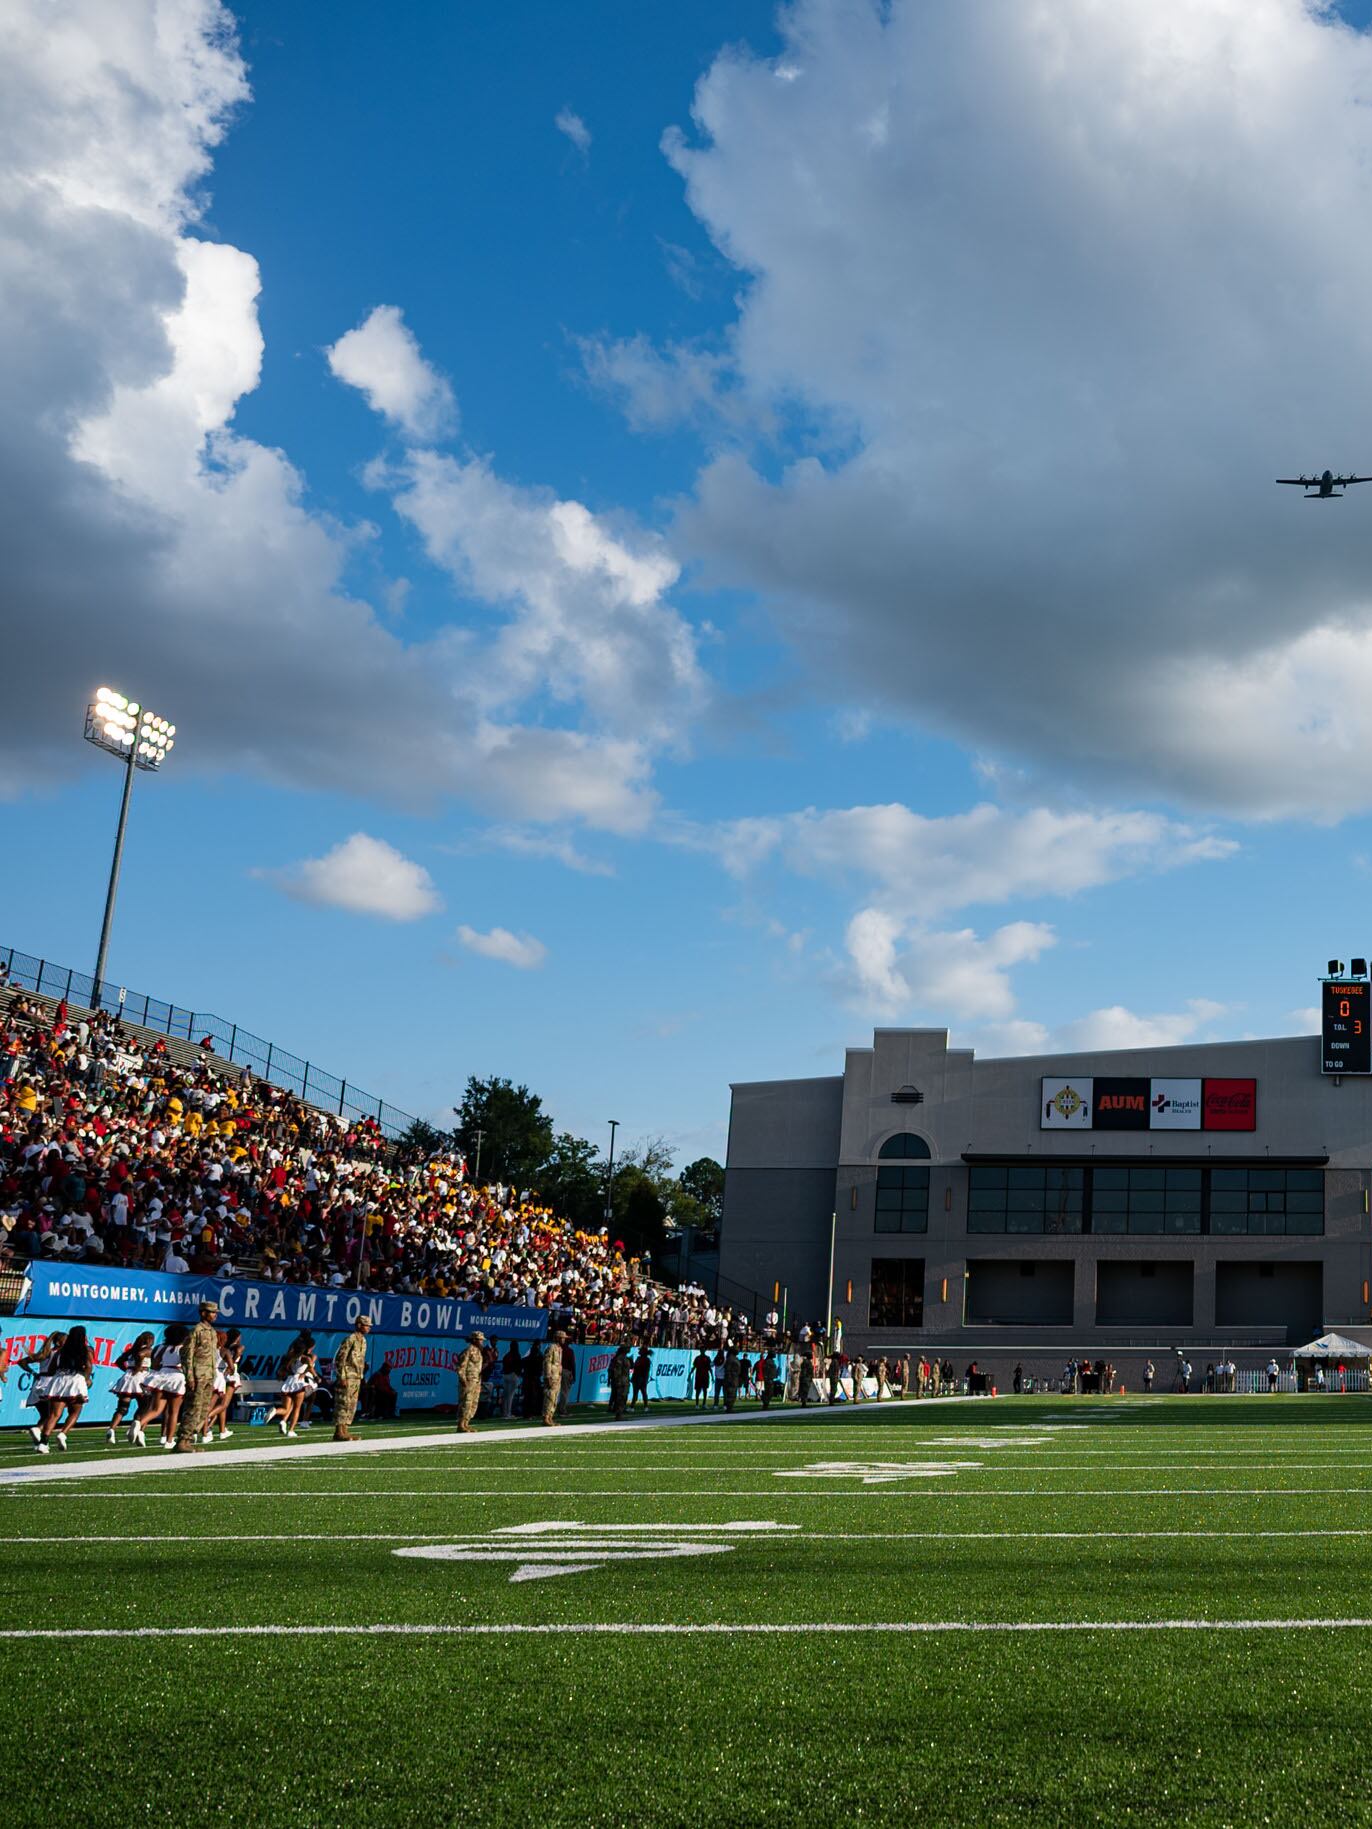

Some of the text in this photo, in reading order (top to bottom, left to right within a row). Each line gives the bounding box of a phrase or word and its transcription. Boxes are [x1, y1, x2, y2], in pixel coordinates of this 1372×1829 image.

[1340, 1001, 1350, 1017] 0
[1354, 1020, 1362, 1034] 3
[1097, 1095, 1145, 1111] AUM
[1172, 1100, 1199, 1109] Baptist
[49, 1281, 206, 1305] MONTGOMERY, ALABAMA
[219, 1285, 464, 1330] CRAMTON BOWL
[470, 1315, 541, 1328] MONTGOMERY, ALABAMA
[384, 1346, 459, 1372] RED TAILS
[401, 1373, 440, 1386] CLASSIC
